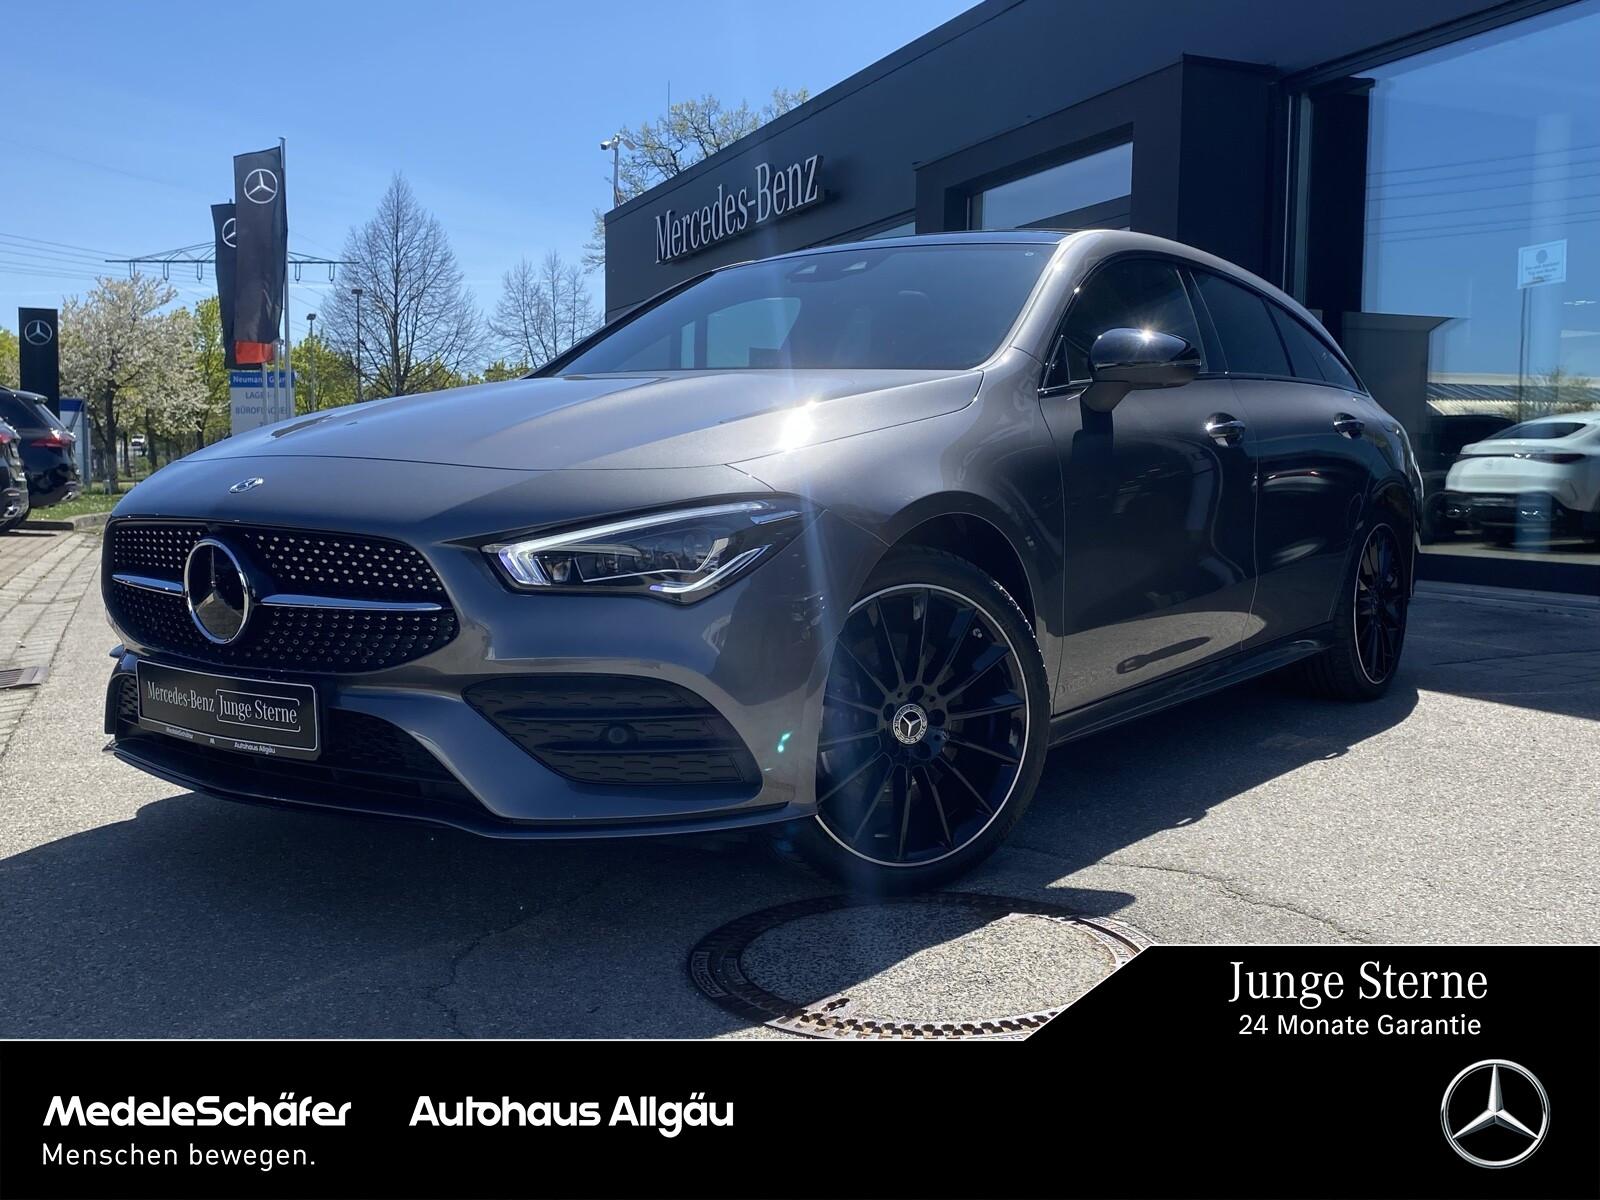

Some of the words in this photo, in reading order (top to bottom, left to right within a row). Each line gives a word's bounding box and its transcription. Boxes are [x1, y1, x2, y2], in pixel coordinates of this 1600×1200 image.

[655, 154, 818, 264] Mercedes-Benz
[147, 681, 215, 712] Mercedes-Benz
[219, 694, 252, 722] Junge
[254, 699, 298, 724] Sterne
